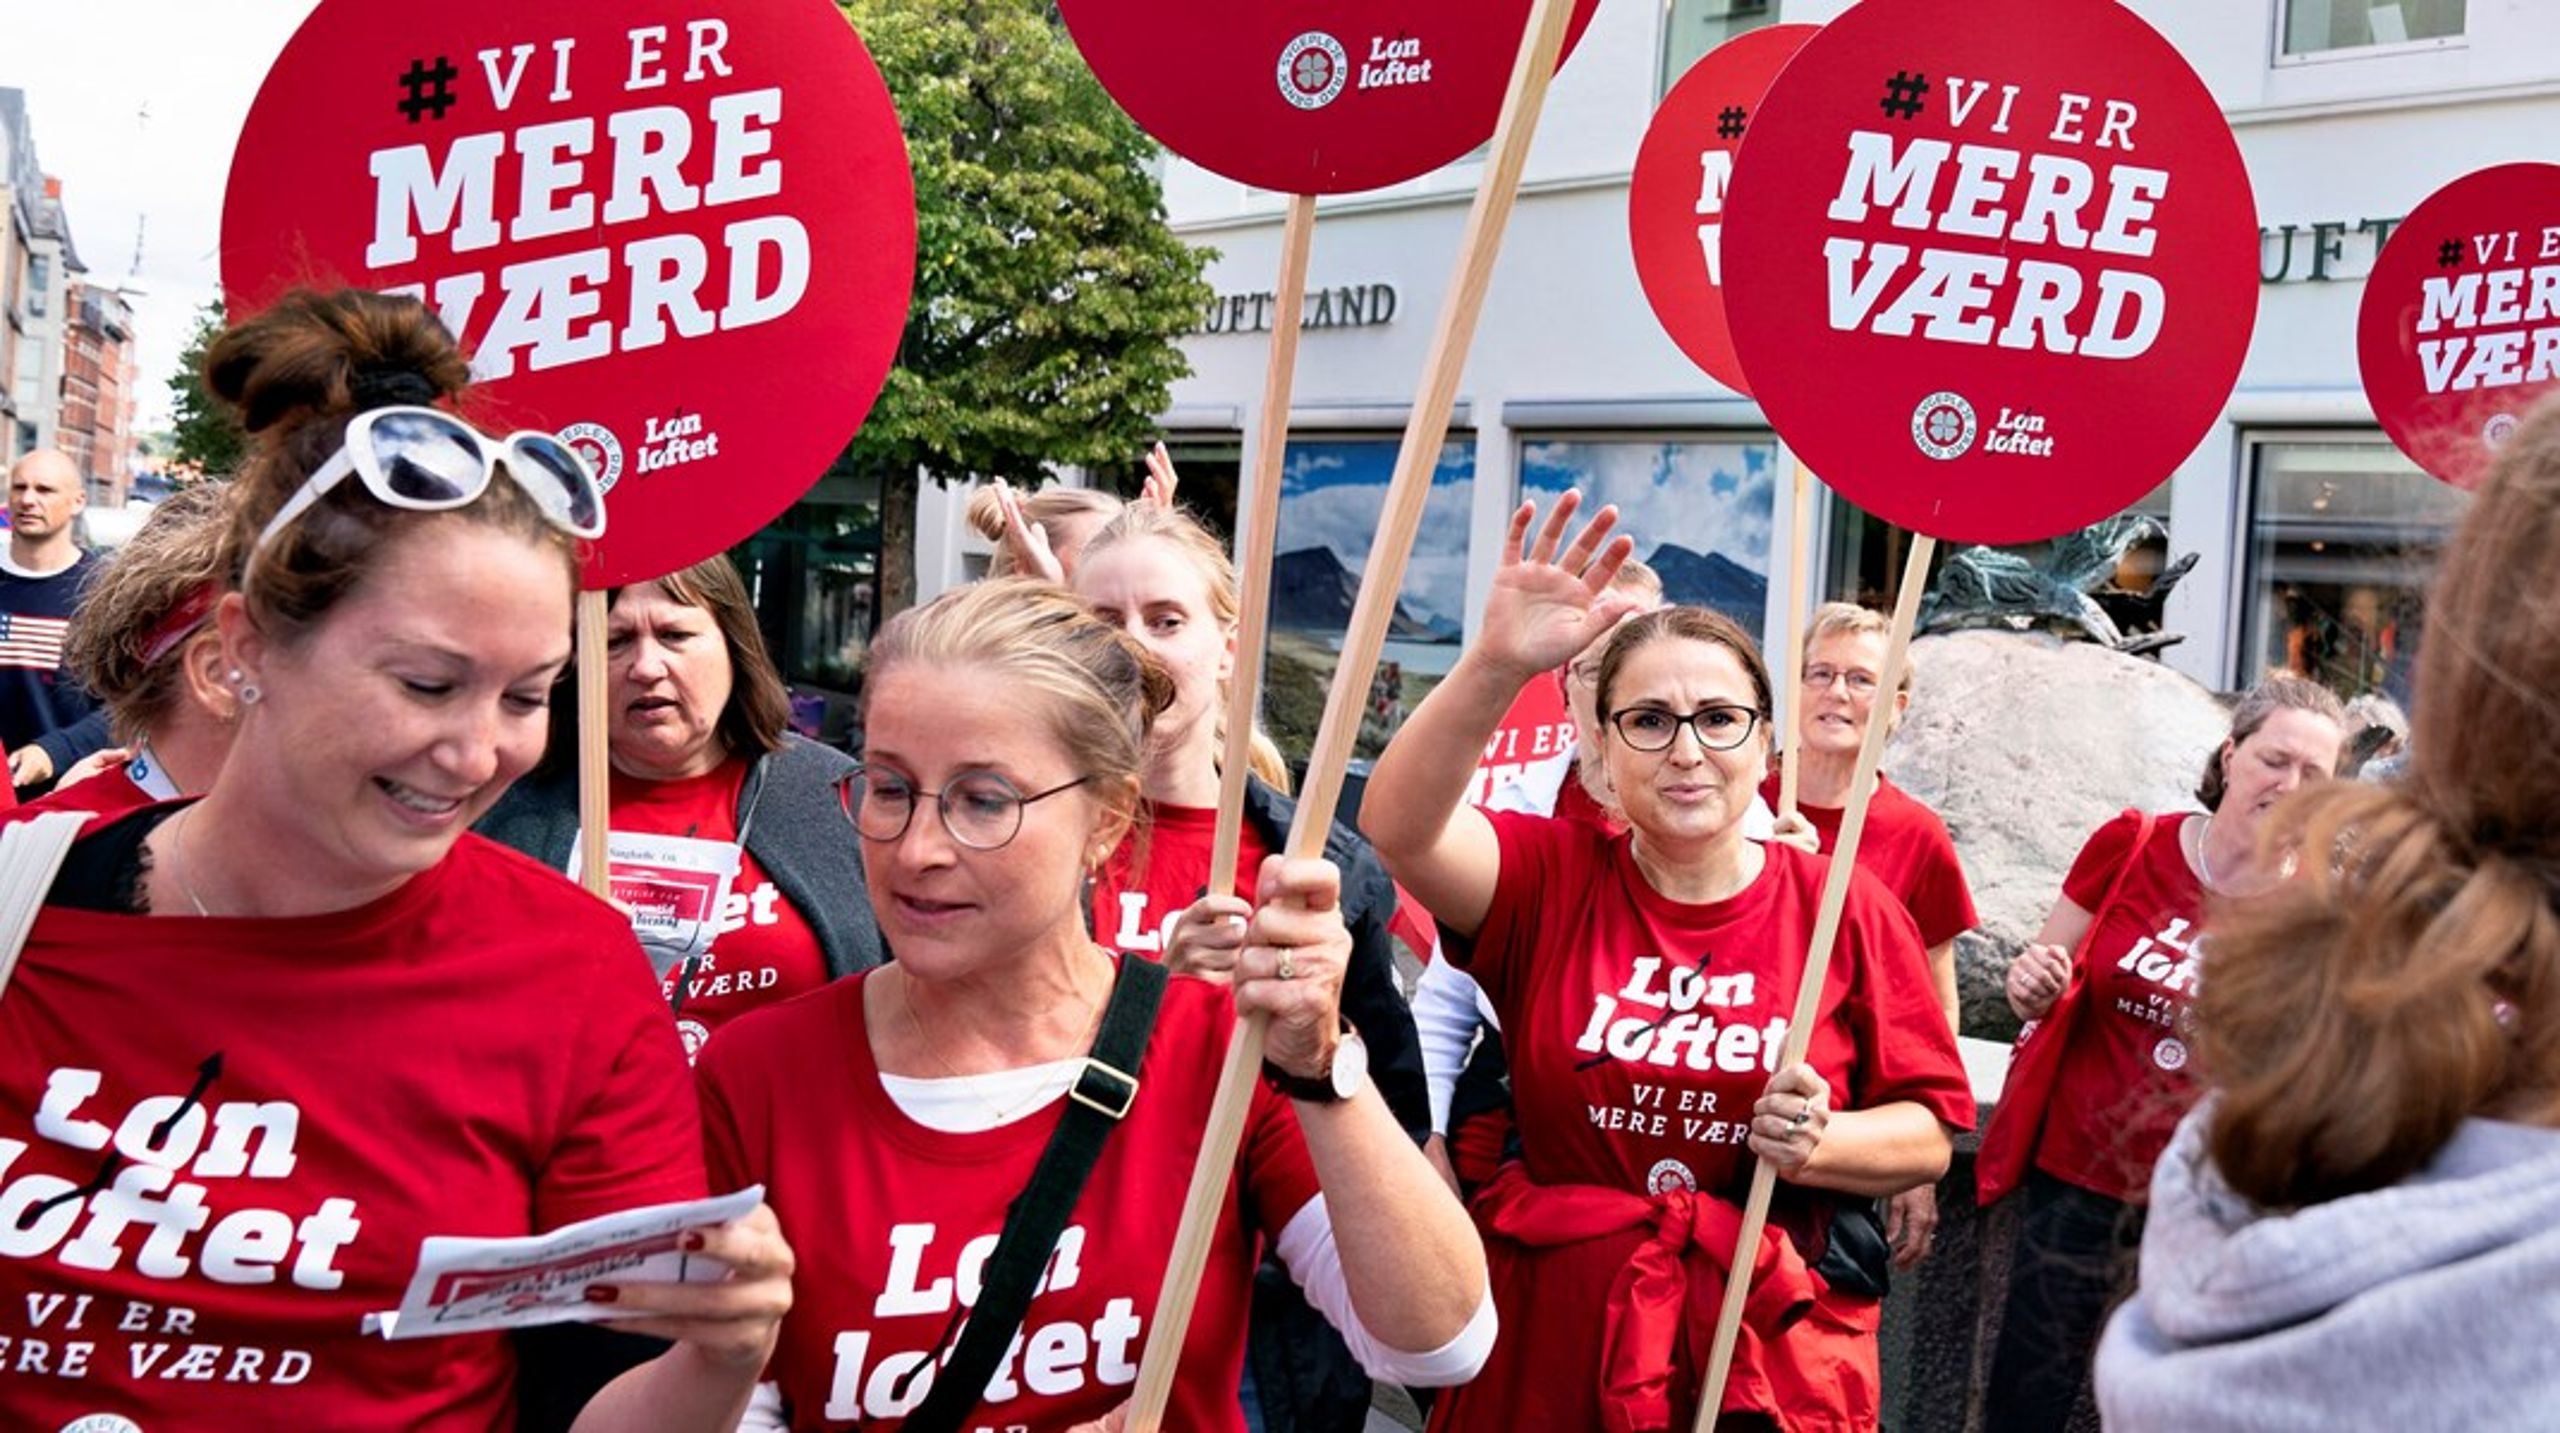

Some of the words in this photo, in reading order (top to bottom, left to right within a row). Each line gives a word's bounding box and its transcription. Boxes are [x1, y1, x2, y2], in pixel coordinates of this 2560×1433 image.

[624, 18, 732, 91] ER
[2050, 94, 2139, 150] ER
[366, 87, 783, 269] MERE
[1827, 130, 2170, 257] MERE
[1822, 238, 2166, 360] VÆRD
[2416, 264, 2560, 333] MER
[2417, 327, 2560, 394] VÆR
[687, 967, 779, 998] VÆRD
[1588, 1105, 1668, 1137] MERE
[1683, 1119, 1750, 1145] VÆR
[1632, 1083, 1666, 1109] VI
[1677, 1091, 1718, 1113] ER
[26, 1292, 94, 1333] VI
[119, 1303, 198, 1336] ER
[0, 1336, 95, 1379] ERE
[128, 1342, 313, 1385] VÆRD
